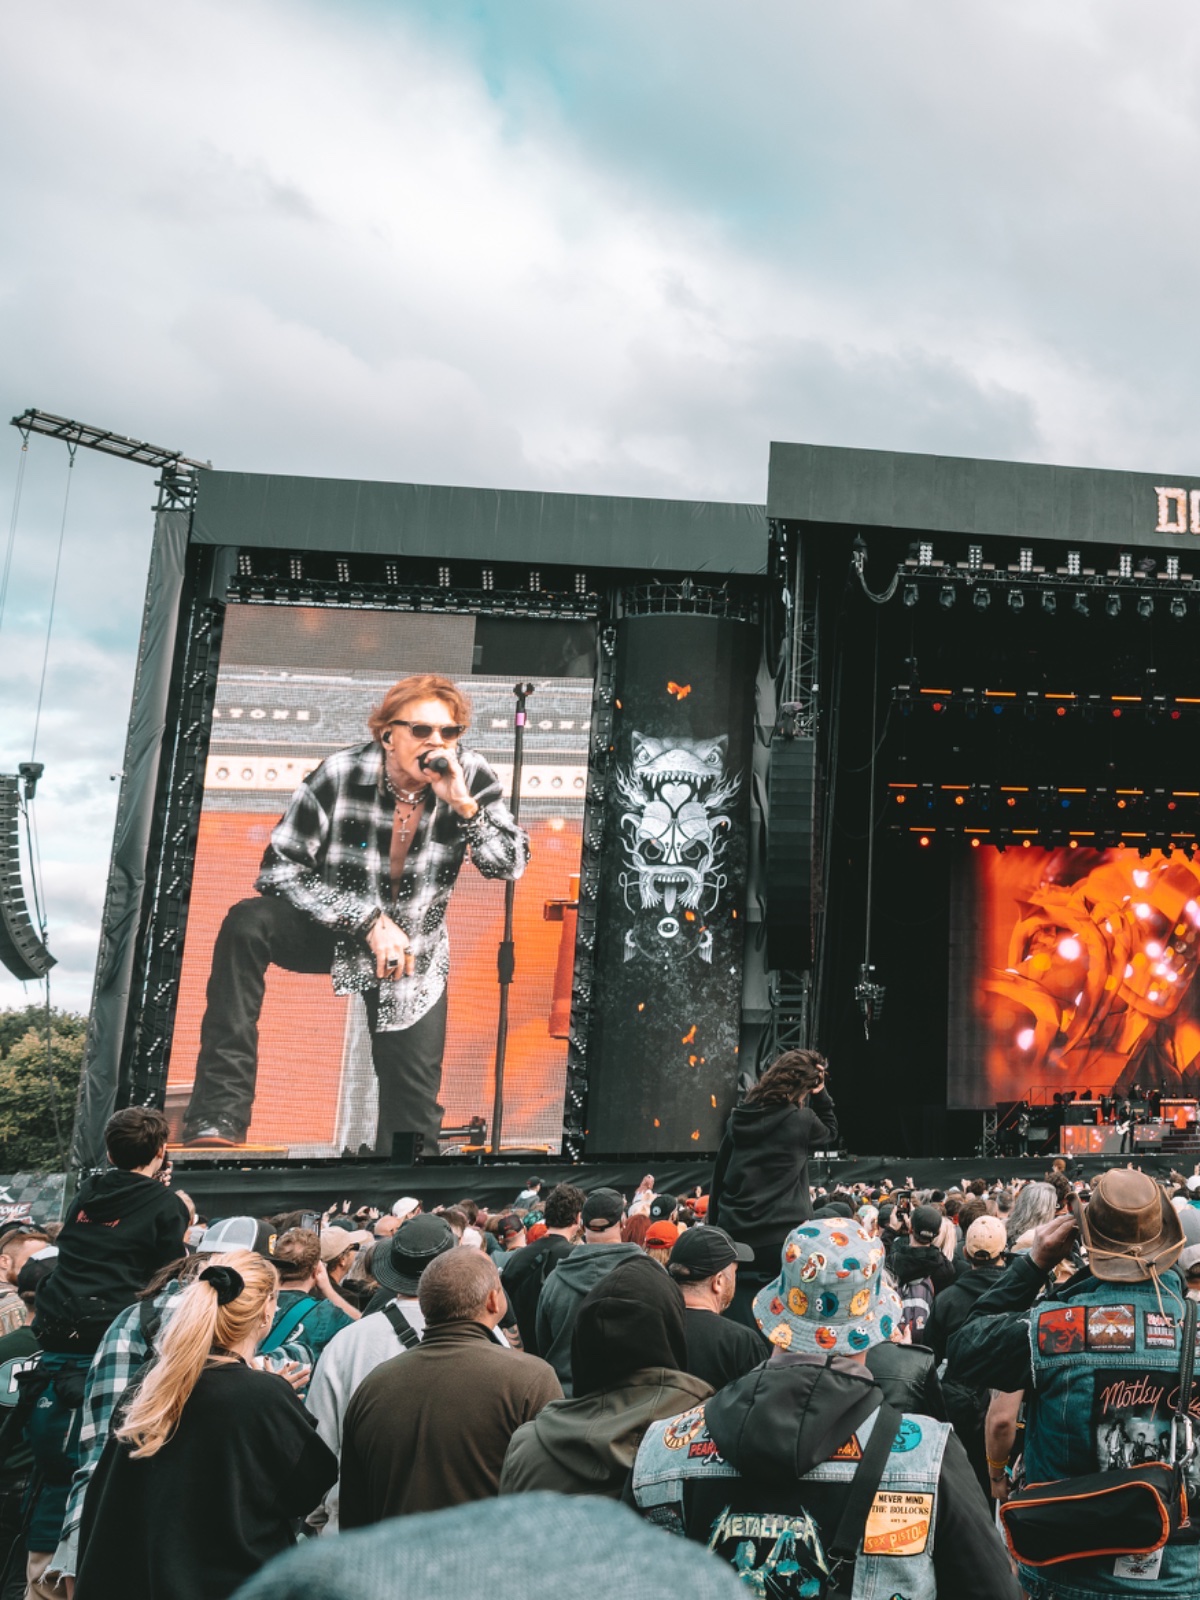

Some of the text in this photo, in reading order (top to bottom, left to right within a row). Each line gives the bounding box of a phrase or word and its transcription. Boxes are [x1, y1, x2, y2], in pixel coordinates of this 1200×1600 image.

[1100, 1375, 1164, 1421] Mötley
[878, 1494, 924, 1505] NEVER MIND
[889, 1506, 930, 1515] BOLLOCKS
[706, 1504, 829, 1575] METALLICA
